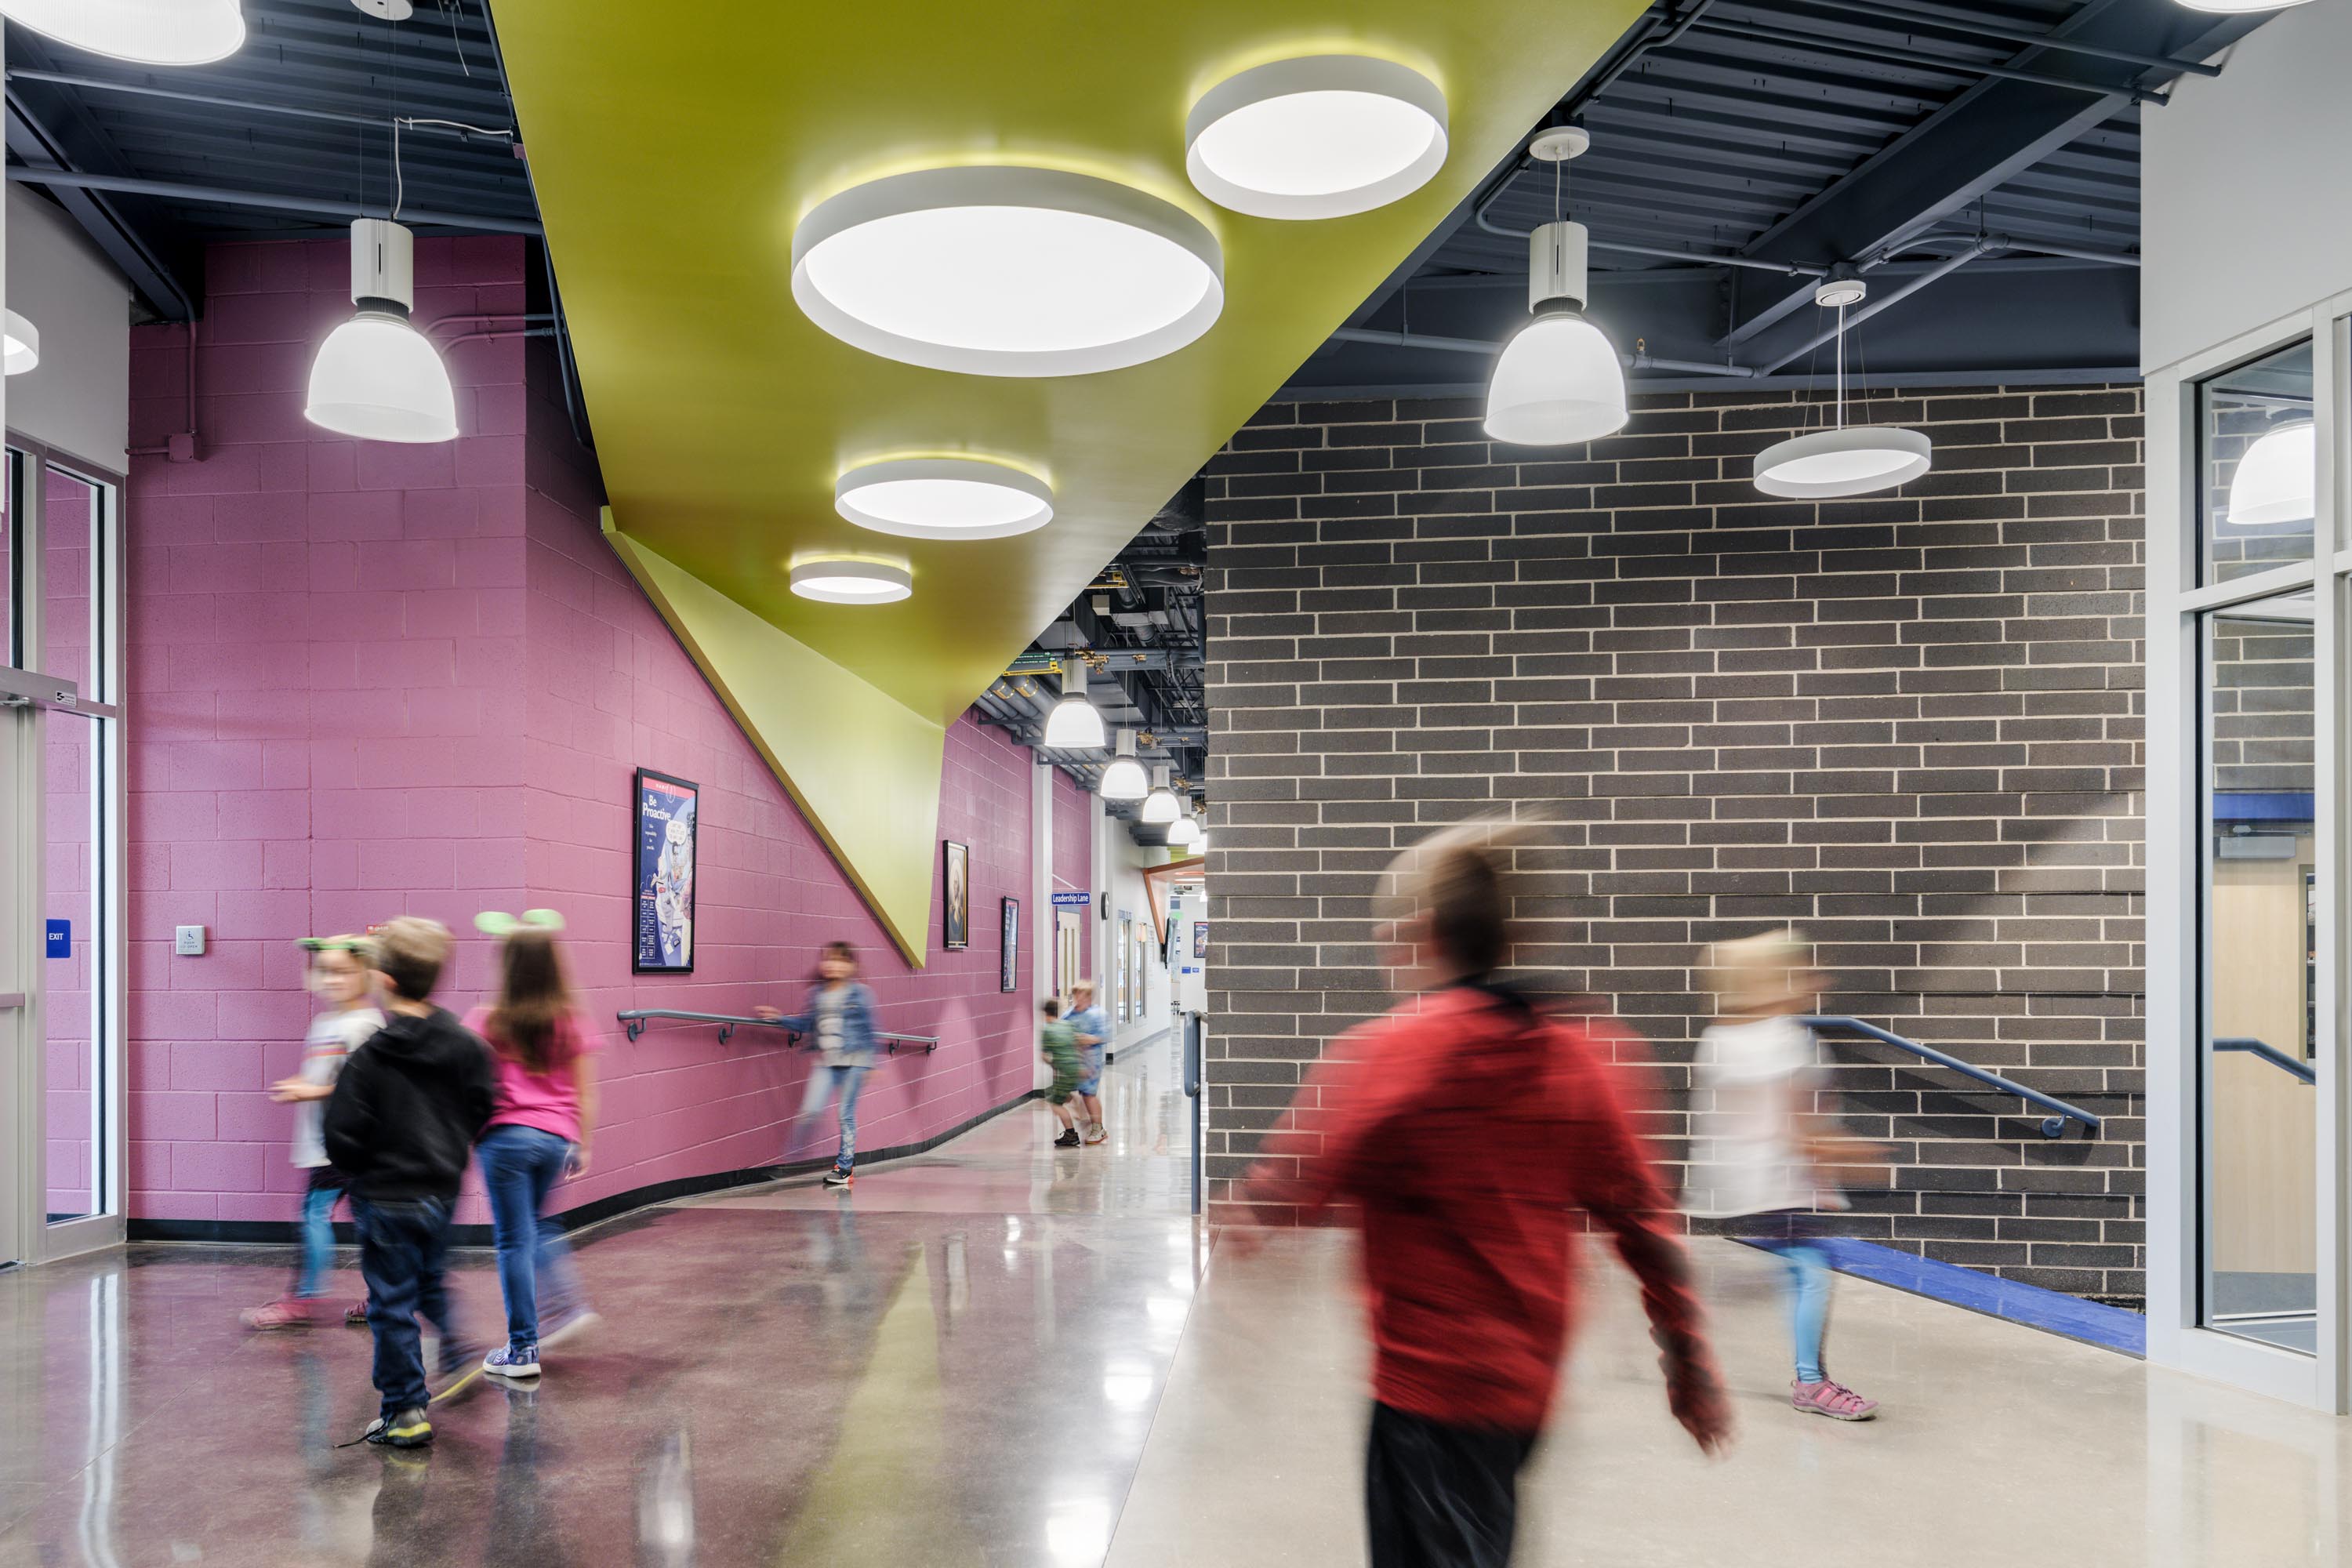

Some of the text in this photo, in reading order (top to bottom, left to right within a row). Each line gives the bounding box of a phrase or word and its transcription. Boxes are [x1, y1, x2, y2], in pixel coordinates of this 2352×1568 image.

[648, 794, 657, 807] Be
[642, 802, 671, 821] Proactive
[1053, 894, 1077, 904] Leadership
